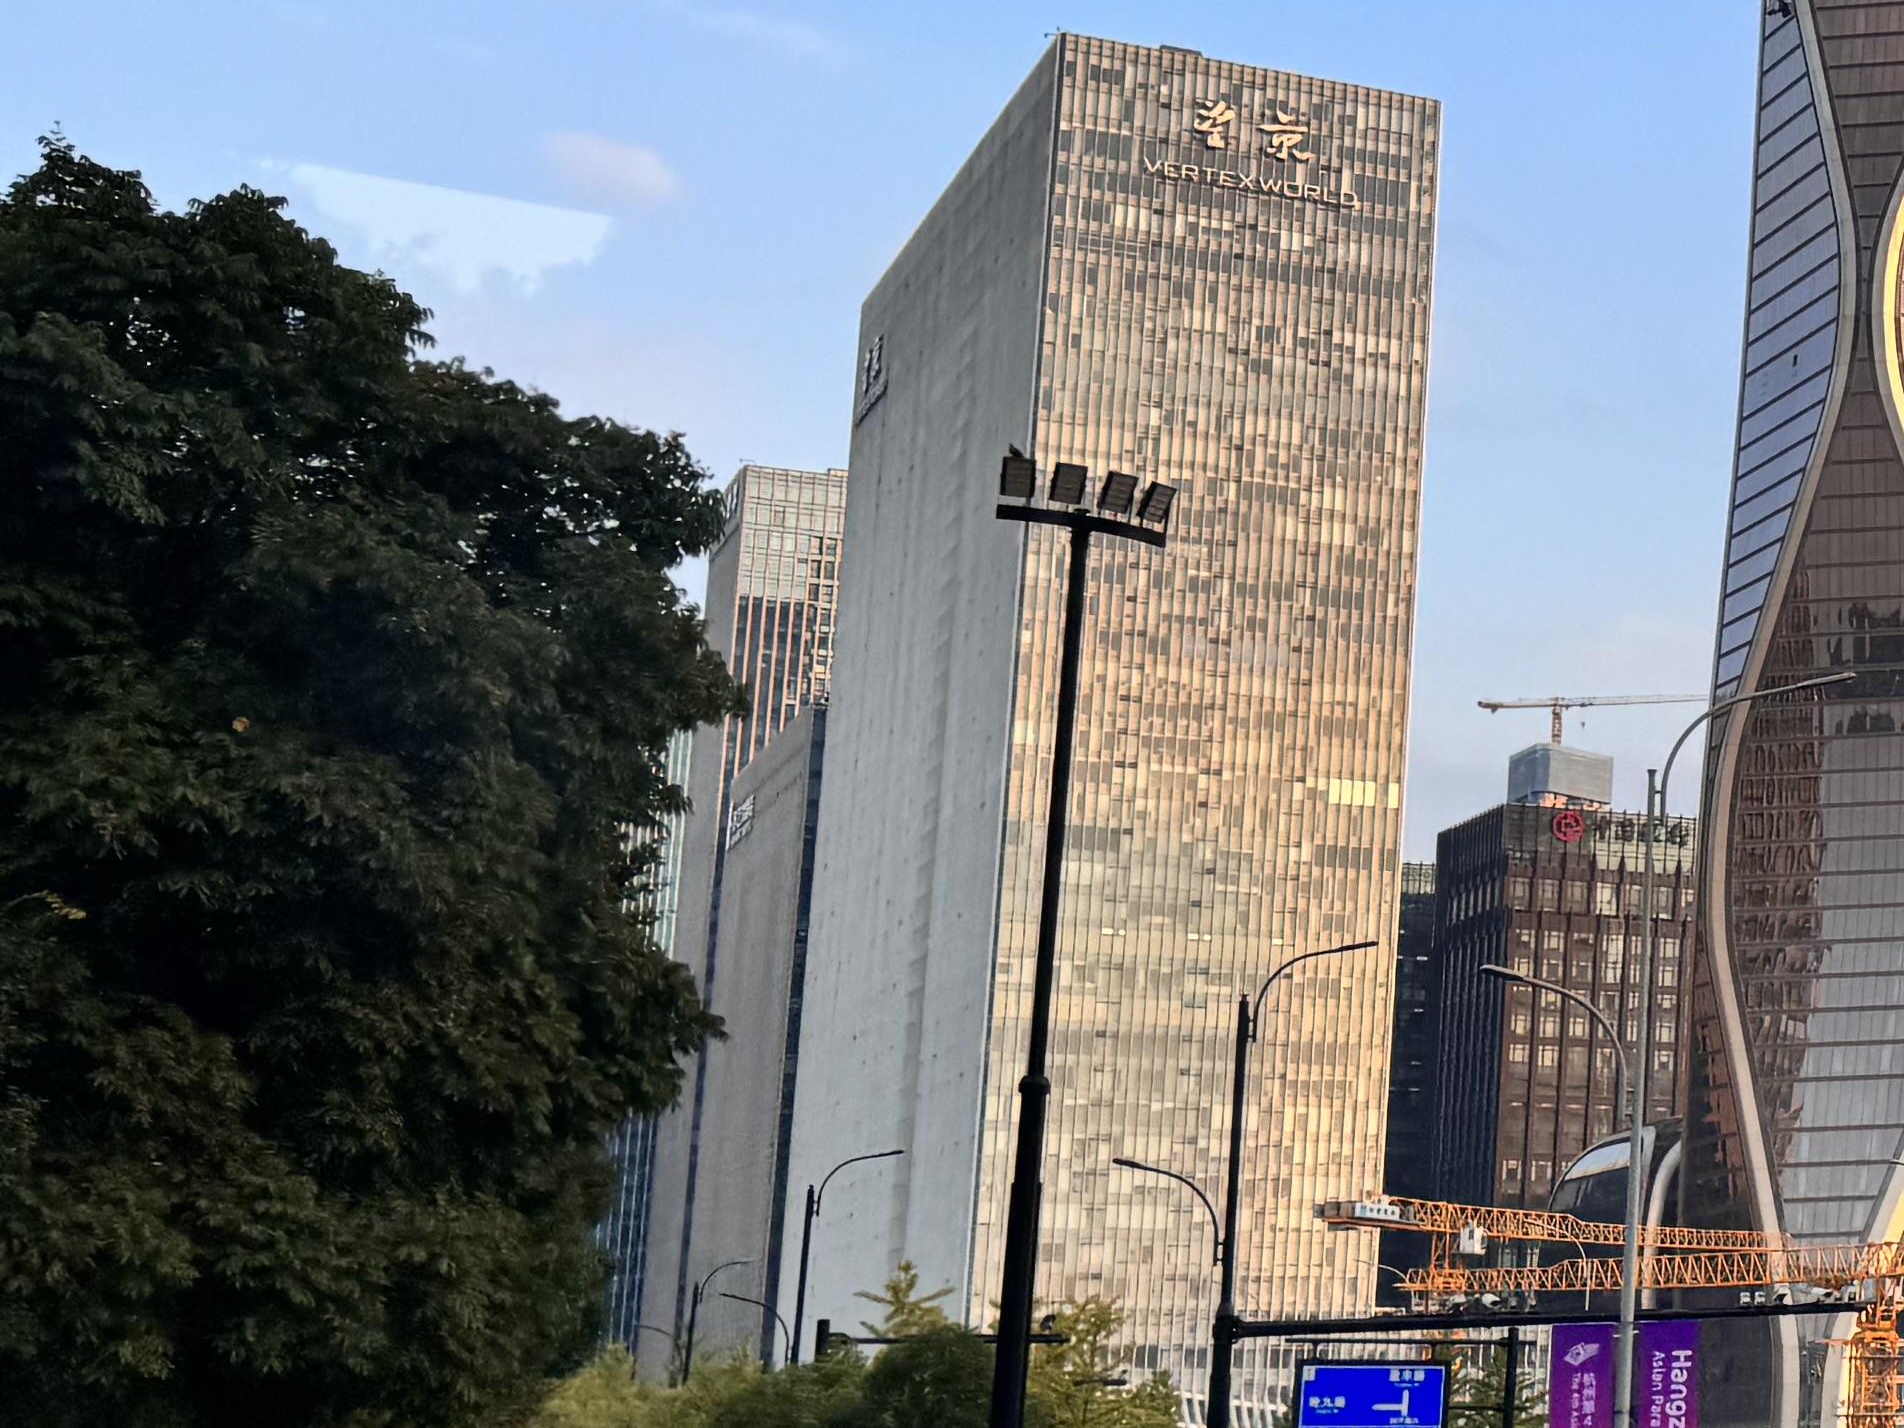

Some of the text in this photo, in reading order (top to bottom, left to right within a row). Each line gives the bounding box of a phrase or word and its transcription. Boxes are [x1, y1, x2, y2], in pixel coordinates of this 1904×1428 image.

[1143, 156, 1361, 210] VERTEX WORLD
[1651, 1350, 1666, 1391] Asian
[1650, 1395, 1664, 1428] Para
